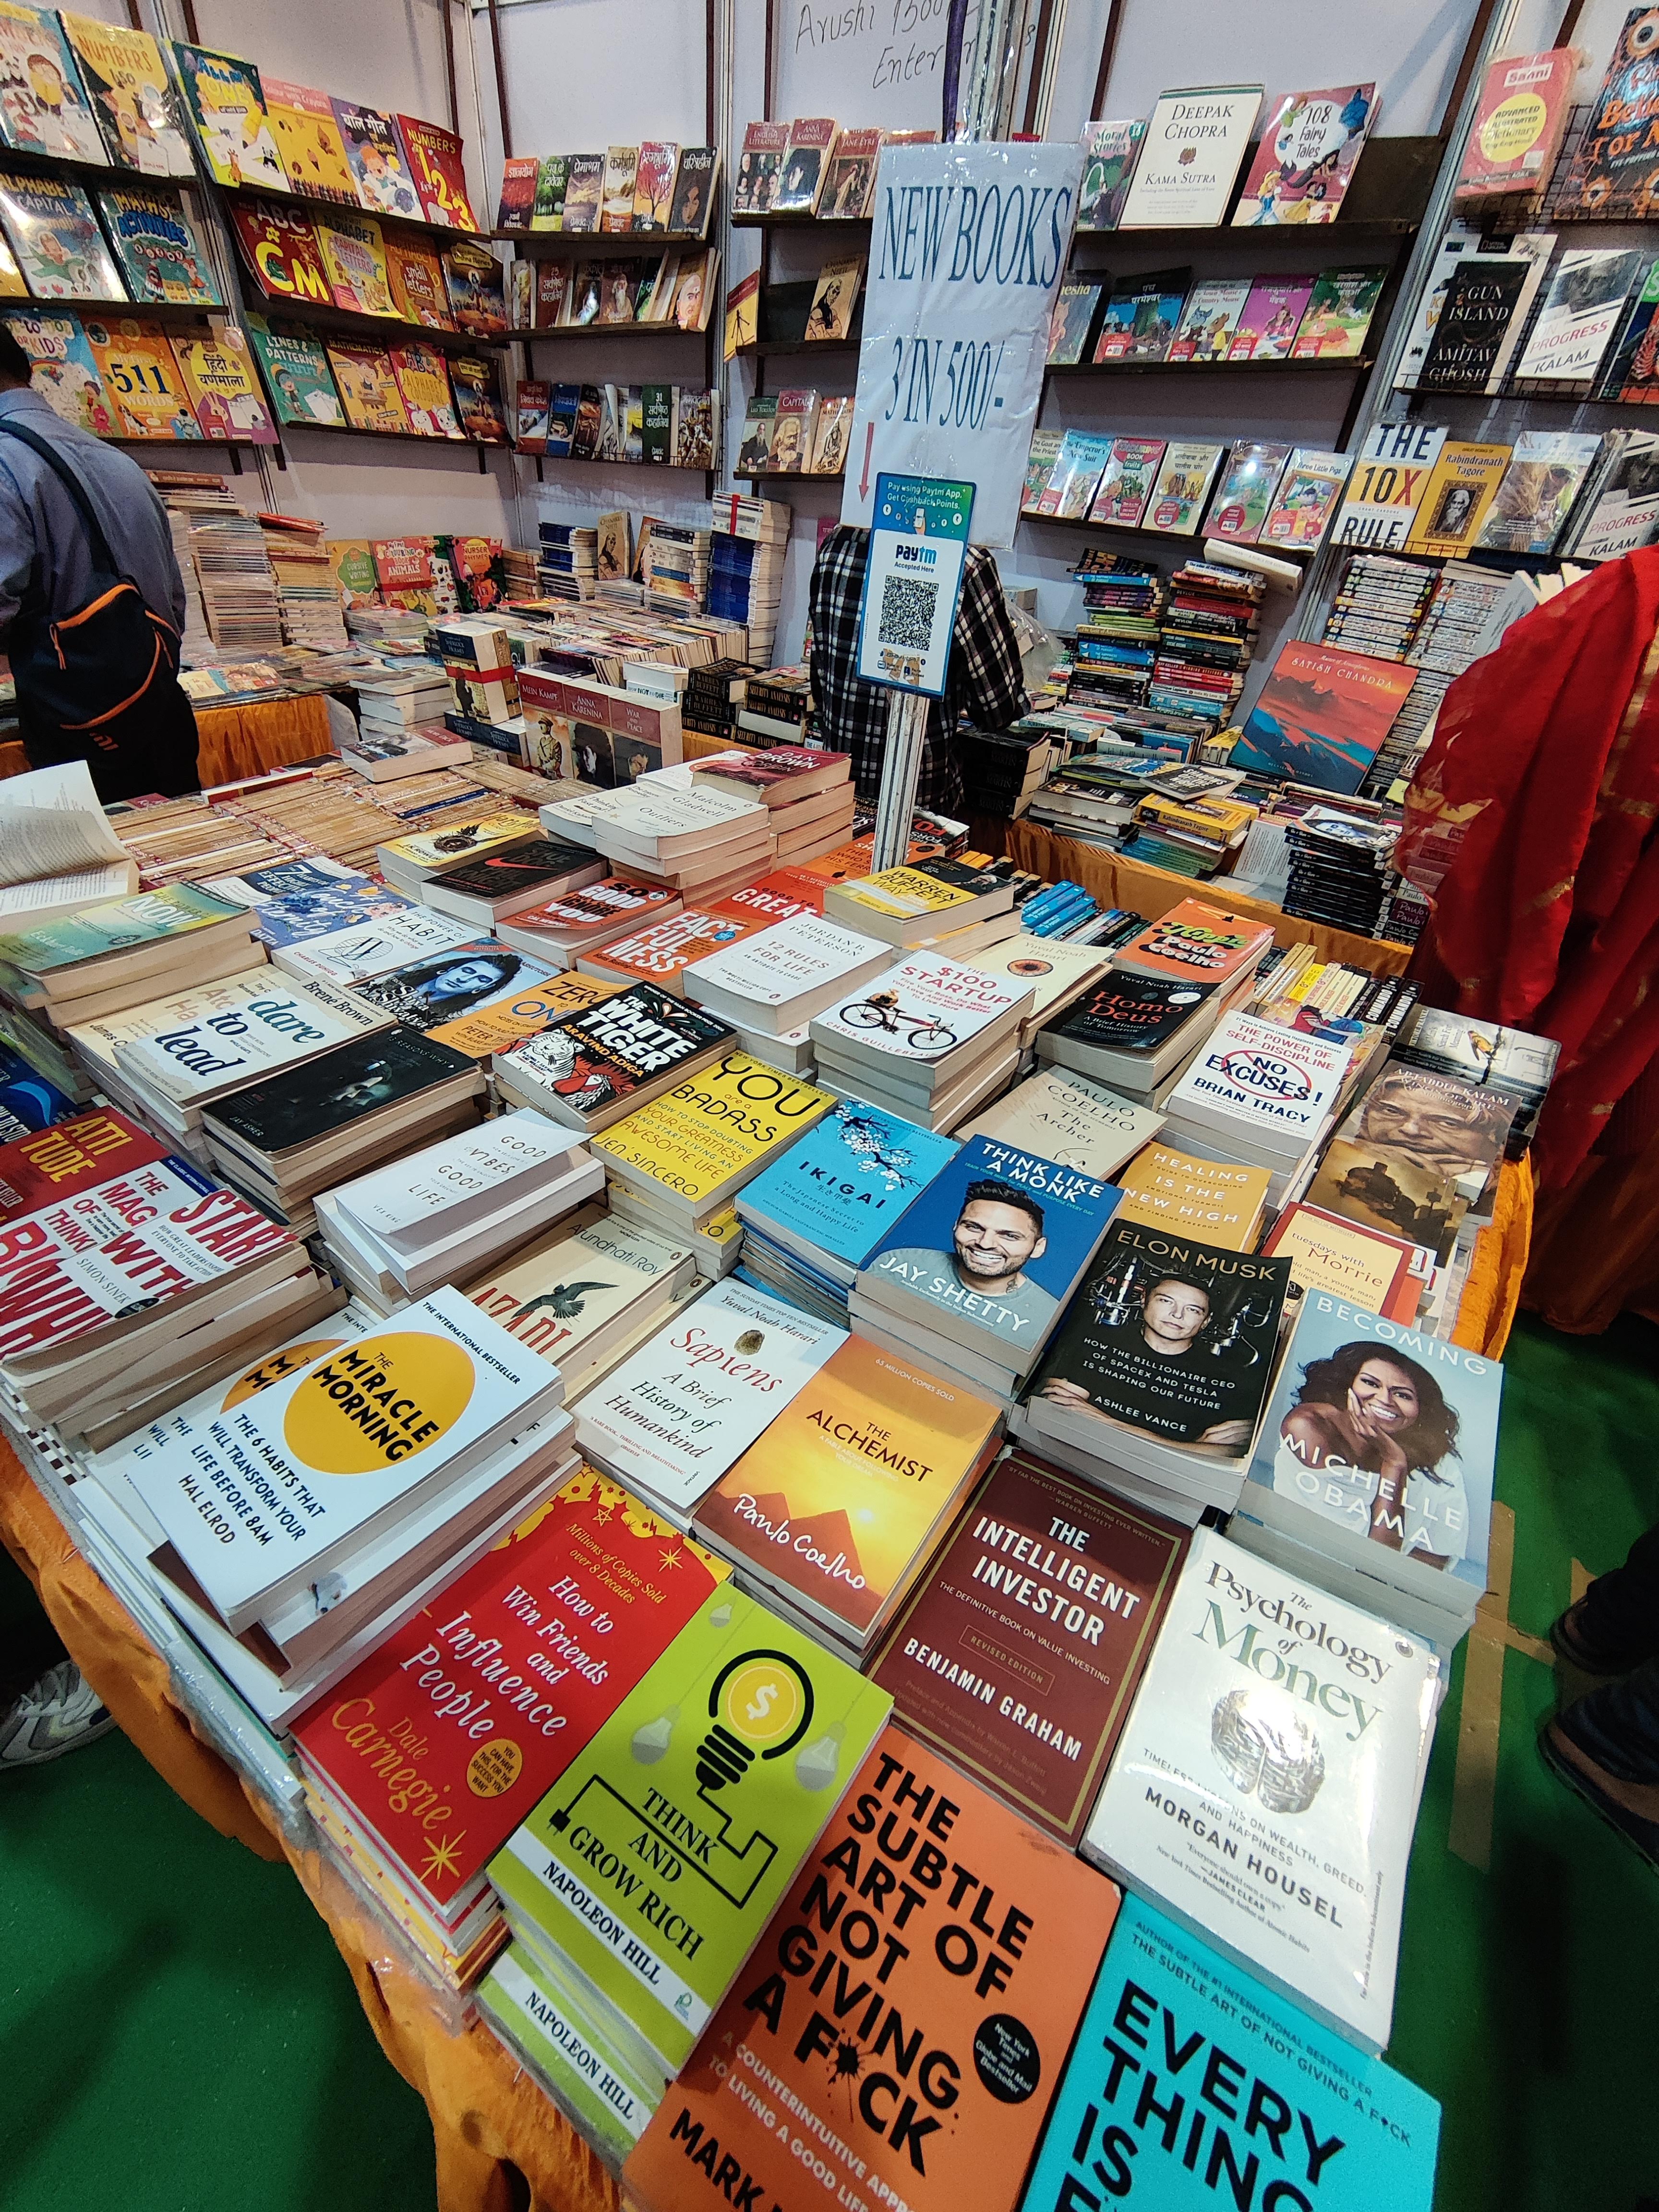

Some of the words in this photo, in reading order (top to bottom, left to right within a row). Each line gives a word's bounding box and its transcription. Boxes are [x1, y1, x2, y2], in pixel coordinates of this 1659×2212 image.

[76, 34, 153, 72] NUMBERS
[1172, 105, 1236, 120] DEEPAK
[1305, 105, 1331, 124] 108
[408, 128, 456, 154] NUMBERS
[1165, 124, 1228, 140] CHOPRA
[1300, 126, 1326, 144] Fairy
[1296, 145, 1320, 159] Tales
[1145, 173, 1178, 185] KAMA
[1180, 172, 1215, 184] SUTRA
[879, 186, 952, 280] NEW
[949, 184, 1071, 289] BOOKS
[405, 264, 426, 282] small
[405, 276, 432, 298] letters
[1468, 287, 1503, 300] GUN
[1448, 307, 1508, 321] ISLAND
[266, 337, 300, 350] LINES
[301, 341, 308, 352] &
[329, 339, 384, 355] MATHEMATICS
[1433, 347, 1495, 361] AMITAV
[1530, 321, 1610, 353] PROGRESS
[266, 348, 318, 365] PATTERNS
[1535, 349, 1589, 373] KALAM
[111, 362, 169, 394] 511
[886, 336, 902, 421] 3
[904, 339, 943, 422] IN
[1429, 368, 1487, 382] GHOSH
[1375, 424, 1437, 460] THE
[1445, 454, 1503, 467] Rabindranath
[1455, 465, 1485, 476] Tagore
[888, 482, 900, 491] Pay
[945, 489, 962, 498] App.
[1359, 467, 1422, 505] 10X
[1343, 516, 1404, 548] RULE
[388, 565, 420, 576] ANIMALS
[894, 562, 920, 571] Accepted
[896, 545, 937, 564] paytm
[1290, 657, 1332, 673] SATISH
[1336, 669, 1393, 689] CHANDRA
[522, 684, 537, 695] MEIN
[539, 686, 558, 701] KAMPF
[577, 696, 596, 708] ANNA
[572, 703, 602, 720] KARENINA
[626, 708, 640, 719] WAR
[626, 722, 643, 733] PEACE
[755, 753, 820, 769] BROWN
[781, 752, 817, 761] DAN
[638, 806, 687, 829] Outliers
[672, 795, 726, 818] Gladwell
[687, 791, 737, 813] Malcolm
[873, 881, 910, 895] WAY
[880, 874, 951, 906] BUFFETT
[892, 870, 961, 901] WARREN
[388, 914, 455, 946] HABIT
[1164, 936, 1228, 959] Paulo
[752, 947, 778, 961] FOR
[784, 960, 813, 977] LIFE
[768, 940, 782, 950] 12
[784, 946, 830, 970] RULES
[1148, 942, 1225, 969] Coelho
[901, 966, 1012, 1005] STARTUP
[938, 966, 998, 990] $100
[301, 980, 337, 1010] Brené
[334, 1002, 373, 1027] Brown
[1089, 1002, 1163, 1024] Deus
[1090, 991, 1183, 1014] Homo
[206, 1012, 249, 1036] to
[248, 999, 325, 1045] dare
[597, 998, 697, 1060] WHITE
[156, 1025, 246, 1077] lead
[576, 1010, 671, 1071] TIGER
[1252, 1057, 1287, 1076] NO
[712, 1057, 820, 1118] YOU
[672, 1084, 777, 1143] BADASS
[799, 1161, 887, 1210] IKIGAI
[982, 1143, 1054, 1179] THINK
[1056, 1170, 1104, 1199] LIKE
[987, 1161, 1003, 1174] A
[1008, 1166, 1084, 1203] MONK
[567, 1224, 633, 1264] Arundhati
[633, 1257, 664, 1276] Roy
[1117, 1230, 1190, 1263] ELON
[1196, 1253, 1276, 1282] MUSK
[1292, 1233, 1337, 1258] tuesdays
[1341, 1255, 1365, 1268] with
[1308, 1248, 1383, 1287] Morrie
[879, 1257, 927, 1283] JAY
[928, 1276, 1031, 1334] SHETTY
[1316, 1297, 1487, 1377] BECOMING
[670, 1327, 782, 1394] Sapiens
[313, 1365, 414, 1462] MORNING
[338, 1349, 439, 1443] MIRACLE
[630, 1380, 692, 1424] History
[692, 1418, 722, 1434] of
[604, 1395, 712, 1460] Humankind
[866, 1421, 892, 1441] THE
[807, 1409, 934, 1482] ALCHEMIST
[1280, 1432, 1464, 1531] MICHELLE
[178, 1474, 200, 1502] HAL
[197, 1499, 236, 1545] ELROD
[1296, 1471, 1433, 1551] OBAMA
[733, 1494, 790, 1544] Paulo
[793, 1535, 866, 1590] Coelho
[1048, 1517, 1090, 1552] THE
[973, 1516, 1140, 1619] INTELLIGENT
[548, 1576, 598, 1619] How
[589, 1611, 613, 1634] to
[972, 1556, 1104, 1646] INVESTOR
[1290, 1592, 1312, 1611] The
[501, 1585, 541, 1626] Win
[536, 1623, 608, 1685] Friends
[1205, 1561, 1394, 1684] Psychology
[1277, 1636, 1299, 1654] of
[436, 1611, 567, 1736] Influence
[527, 1651, 571, 1684] and
[1192, 1598, 1383, 1742] Money
[399, 1643, 494, 1740] People
[903, 1637, 997, 1705] BENJAMIN
[999, 1696, 1082, 1761] GRAHAM
[387, 1716, 430, 1760] Dale
[332, 1697, 452, 1830] Carnegie
[872, 1753, 961, 1842] THE
[642, 1787, 721, 1866] THINK
[628, 1831, 683, 1883] AND
[1144, 1787, 1239, 1860] MORGAN
[1247, 1854, 1343, 1928] HOUSEL
[569, 1826, 644, 1899] GROW
[640, 1892, 704, 1960] RICH
[846, 1794, 1034, 1960] SUBTLE
[543, 1861, 625, 1952] NAPOLEON
[622, 1940, 665, 1985] HILL
[800, 1875, 909, 1984] NOT
[822, 1838, 926, 1930] ART
[935, 1924, 1013, 1998] OF
[743, 1973, 787, 2034] A
[777, 1924, 961, 2109] GIVING
[1113, 1979, 1346, 2186] EVERY
